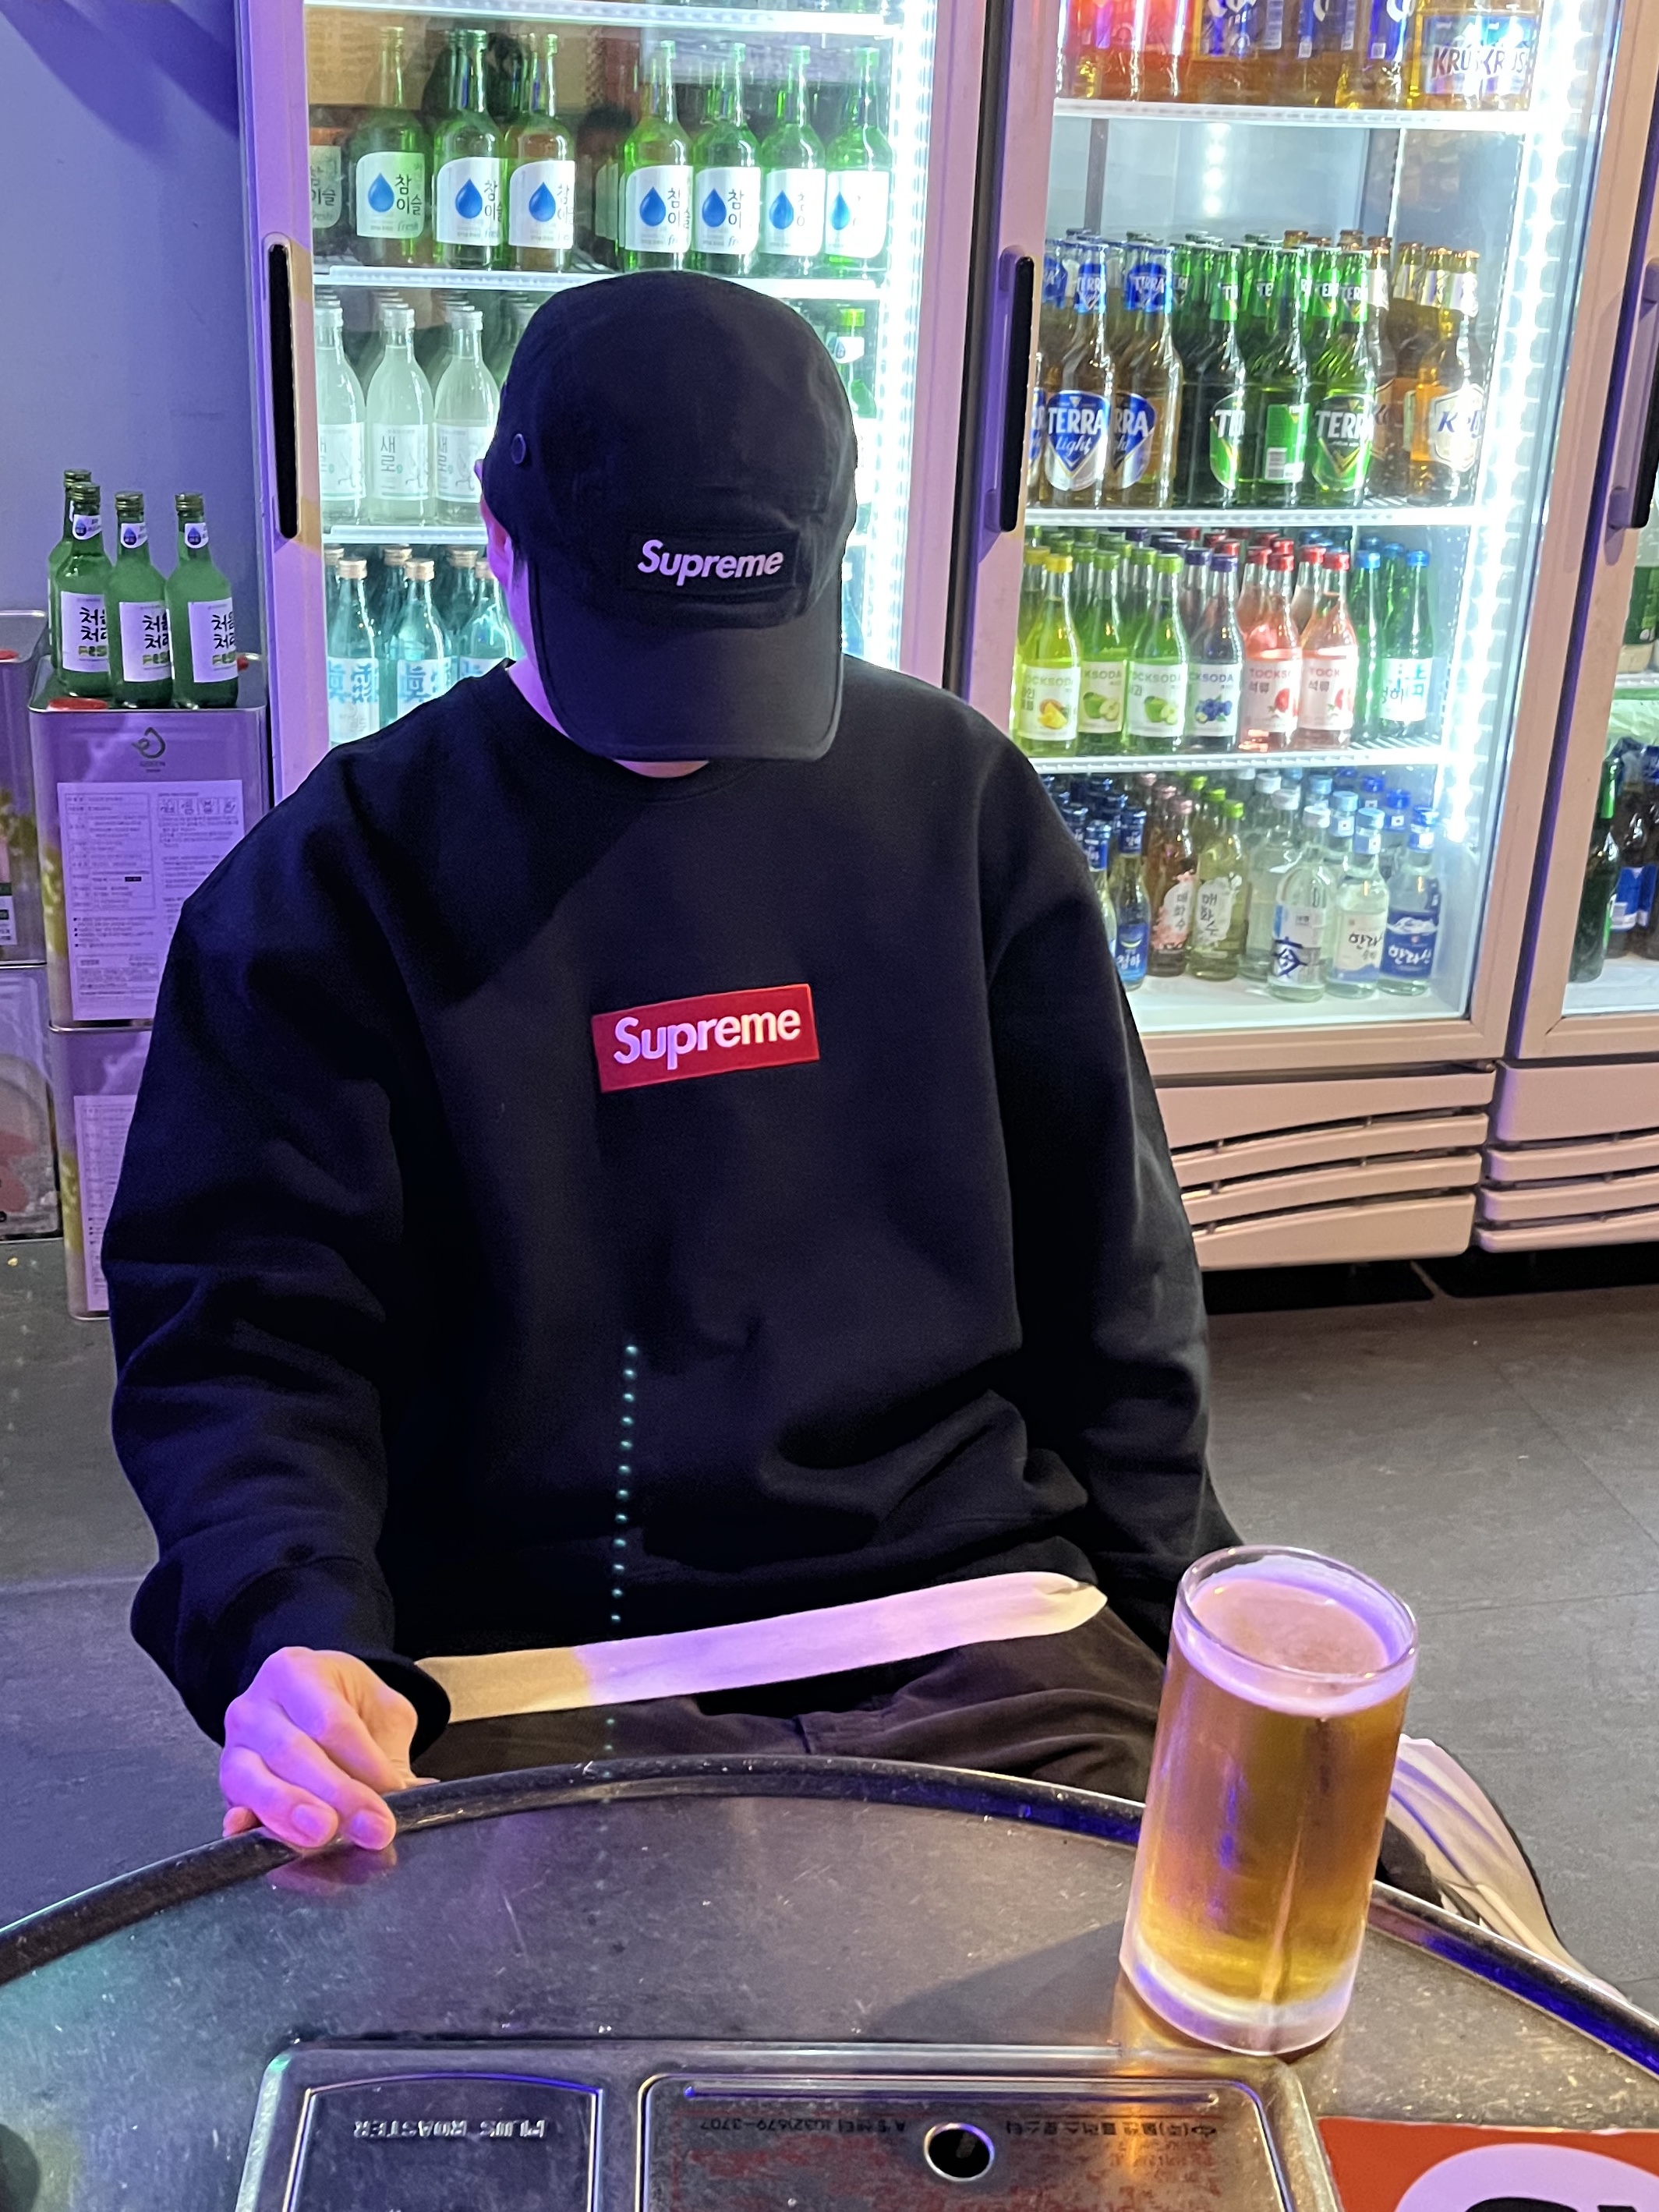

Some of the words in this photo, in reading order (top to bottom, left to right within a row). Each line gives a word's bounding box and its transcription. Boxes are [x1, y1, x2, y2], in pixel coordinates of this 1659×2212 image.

[394, 173, 412, 195] 참
[396, 196, 422, 215] 이슬
[1048, 407, 1105, 436] TERRA
[638, 539, 784, 586] Supreme
[614, 1009, 801, 1070] Supreme
[354, 2119, 468, 2138] ROASTER
